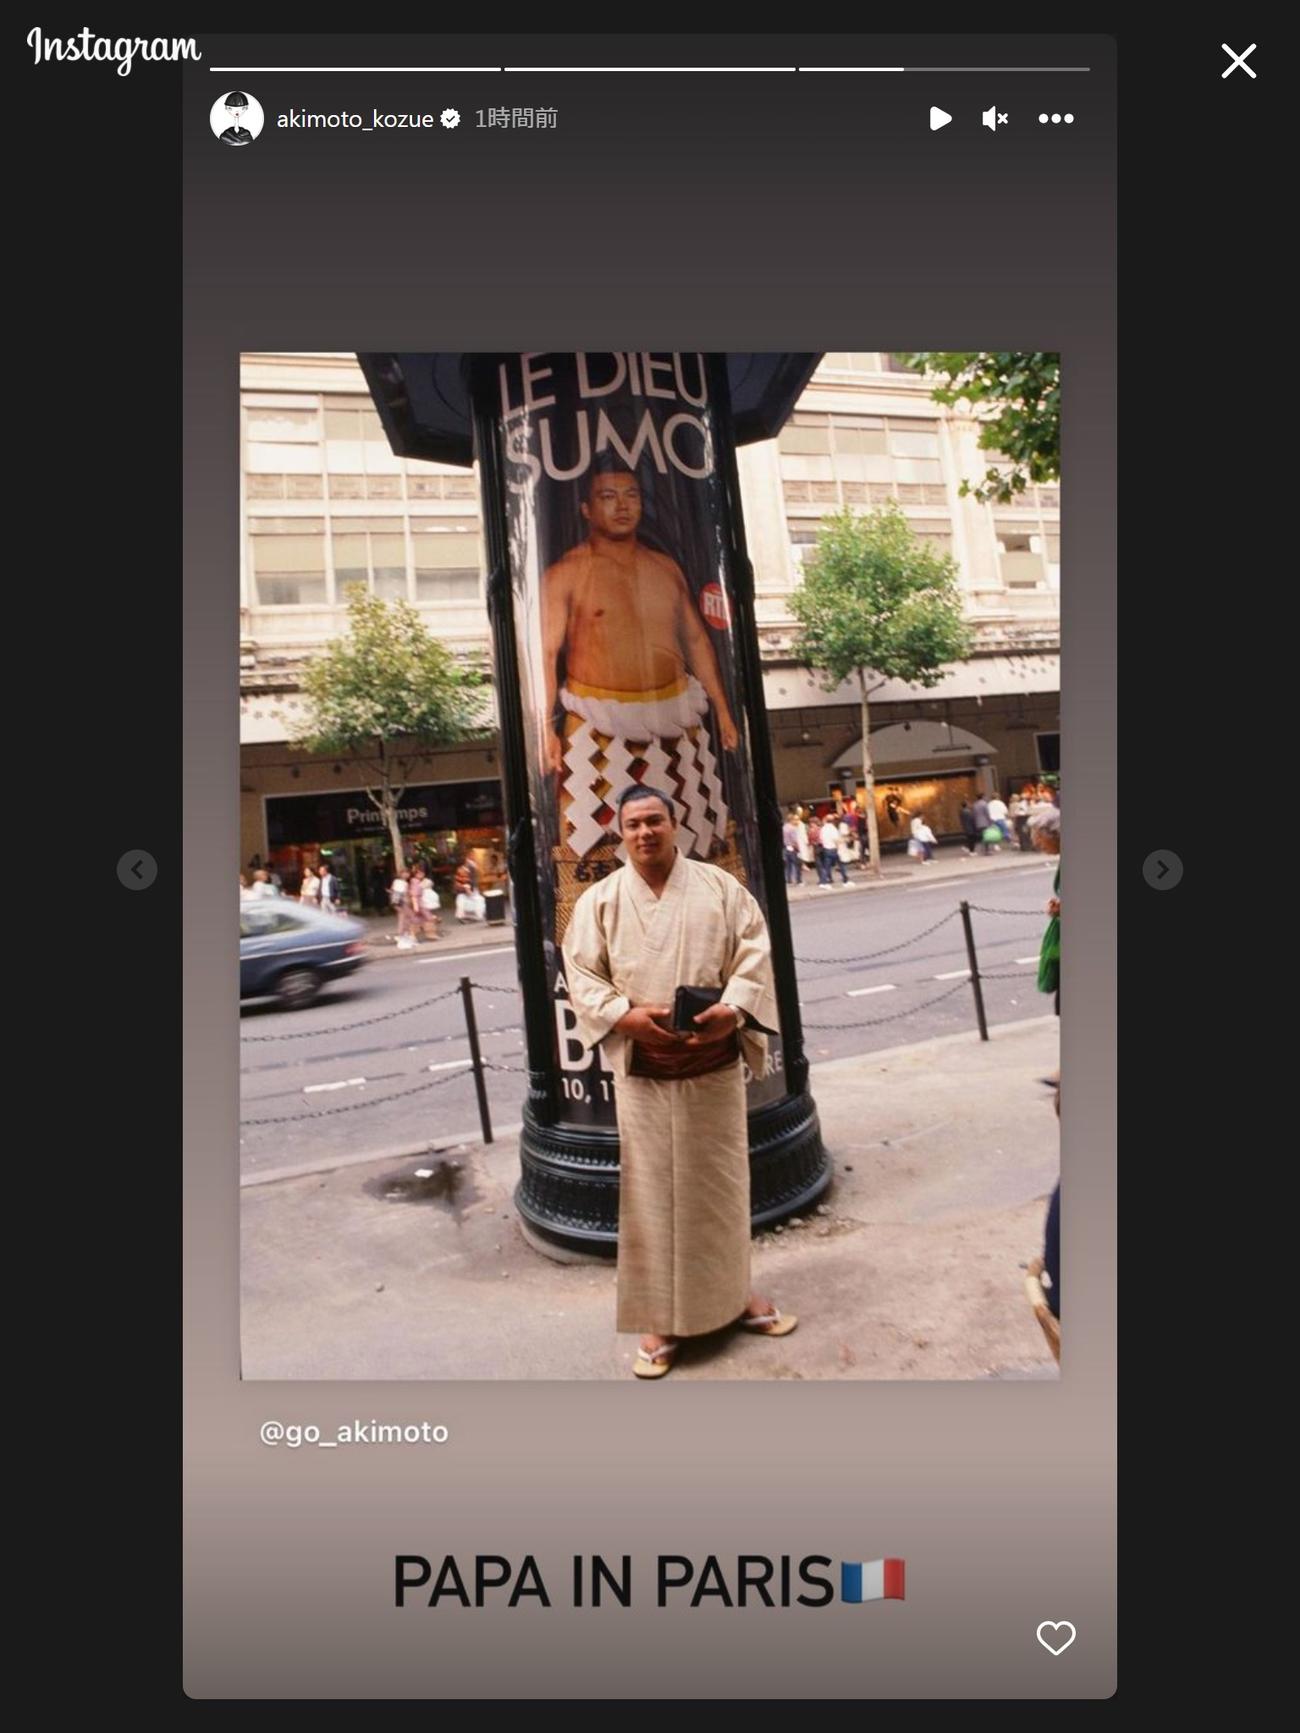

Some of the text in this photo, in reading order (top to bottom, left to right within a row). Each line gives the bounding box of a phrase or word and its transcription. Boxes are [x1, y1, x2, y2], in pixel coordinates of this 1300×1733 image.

[499, 352, 709, 418] LE DIEU
[504, 408, 716, 494] SUMO
[346, 806, 428, 824] Prinmps
